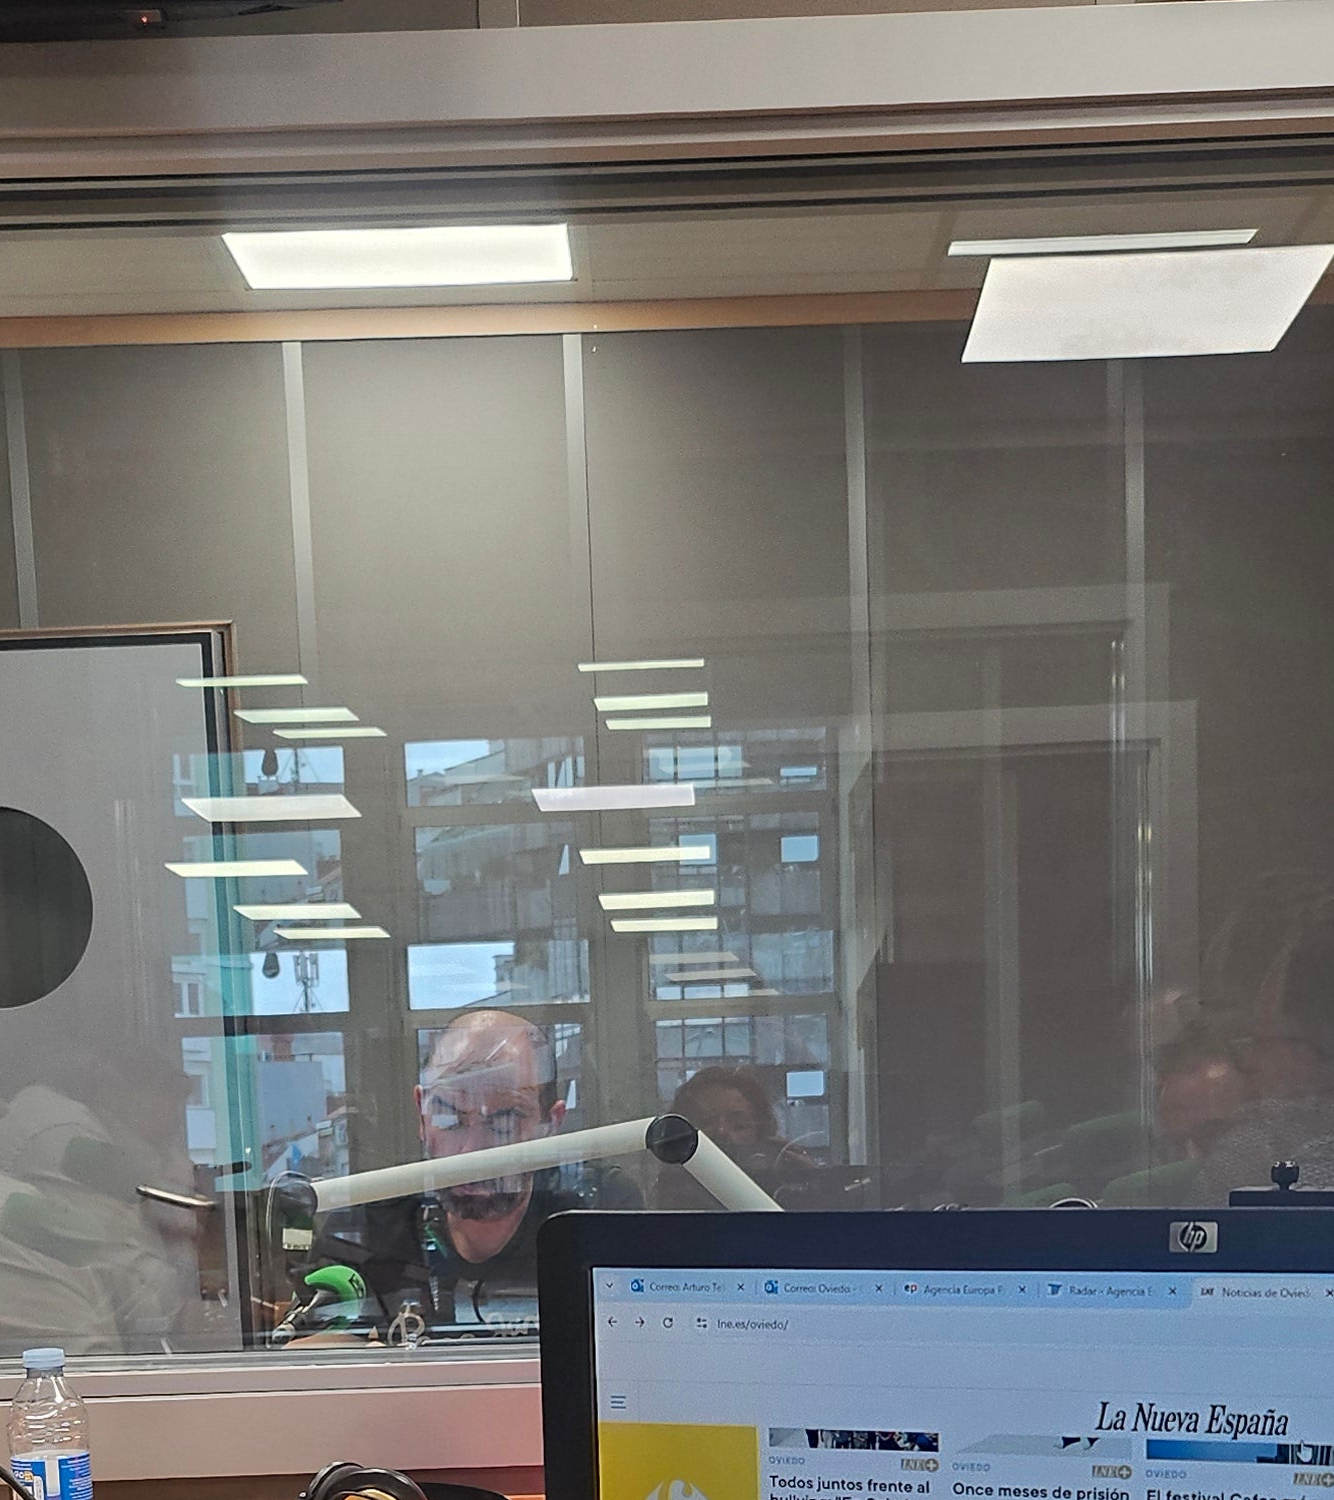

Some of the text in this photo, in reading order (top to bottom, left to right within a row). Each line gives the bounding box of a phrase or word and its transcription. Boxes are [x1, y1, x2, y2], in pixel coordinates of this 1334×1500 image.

[1179, 1223, 1208, 1252] hp
[1094, 1401, 1288, 1440] La Nueva España
[769, 1474, 930, 1493] Todos juntos frente al
[952, 1482, 994, 1496] Once
[998, 1486, 1047, 1498] meses
[1052, 1485, 1072, 1499] de
